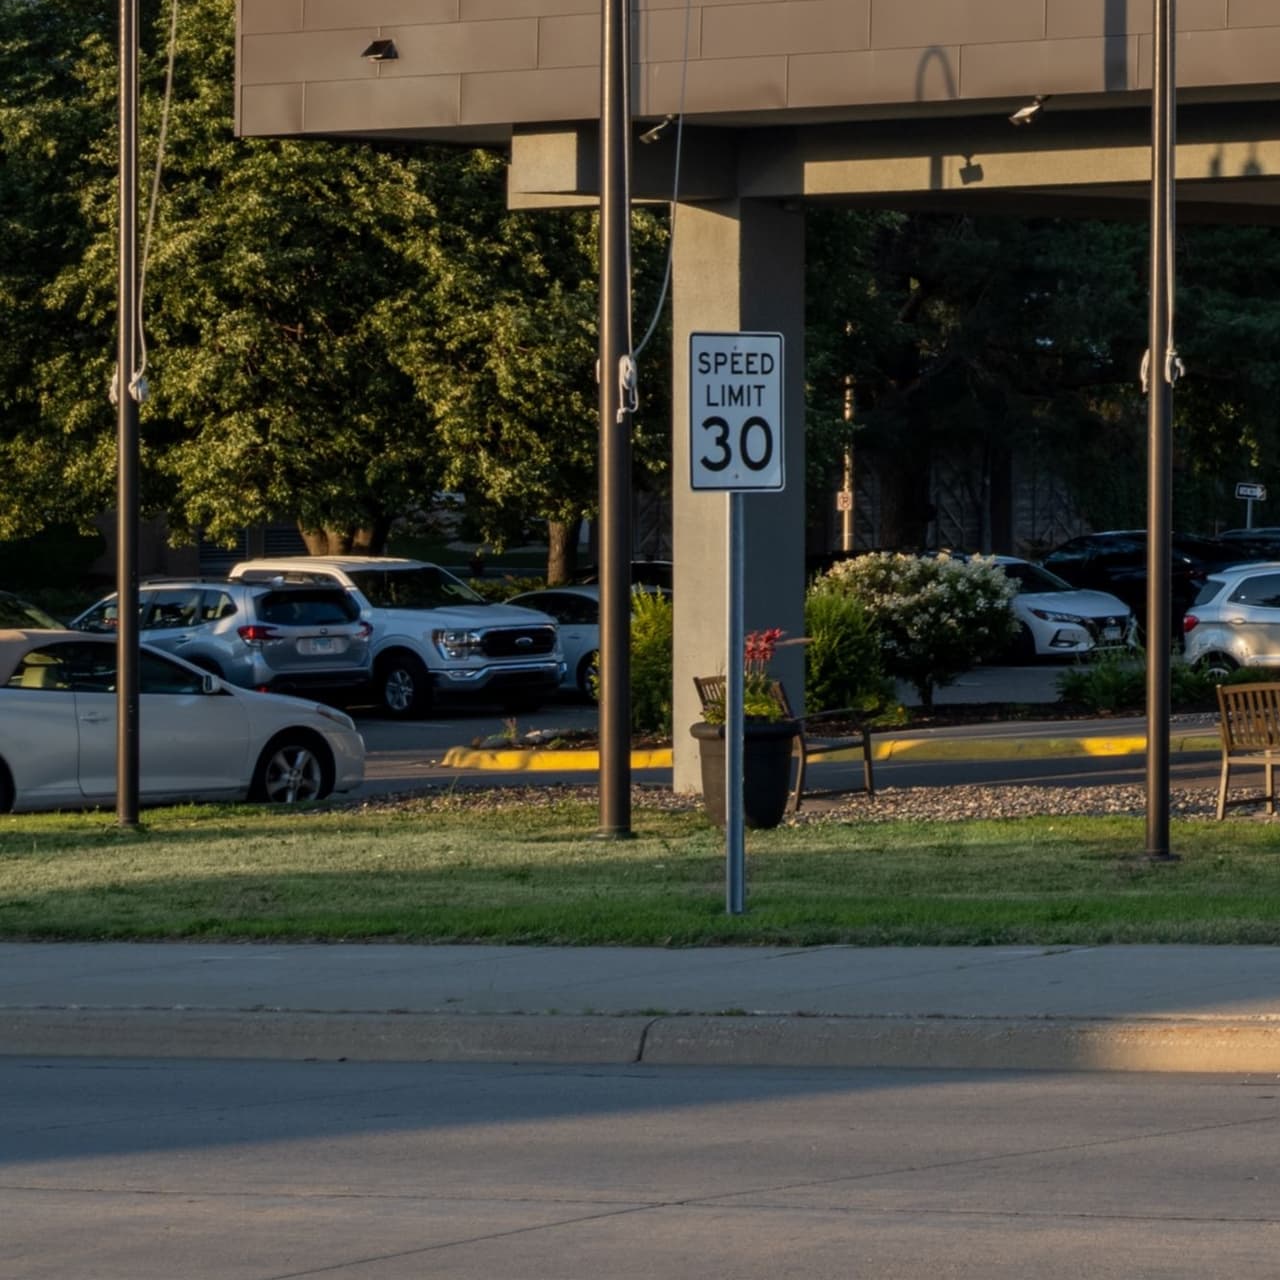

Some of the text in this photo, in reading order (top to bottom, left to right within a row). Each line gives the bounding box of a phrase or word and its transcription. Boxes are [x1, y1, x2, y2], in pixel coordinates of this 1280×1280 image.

[698, 352, 775, 375] SPEED
[706, 385, 766, 407] LIMIT
[700, 416, 773, 472] 30
